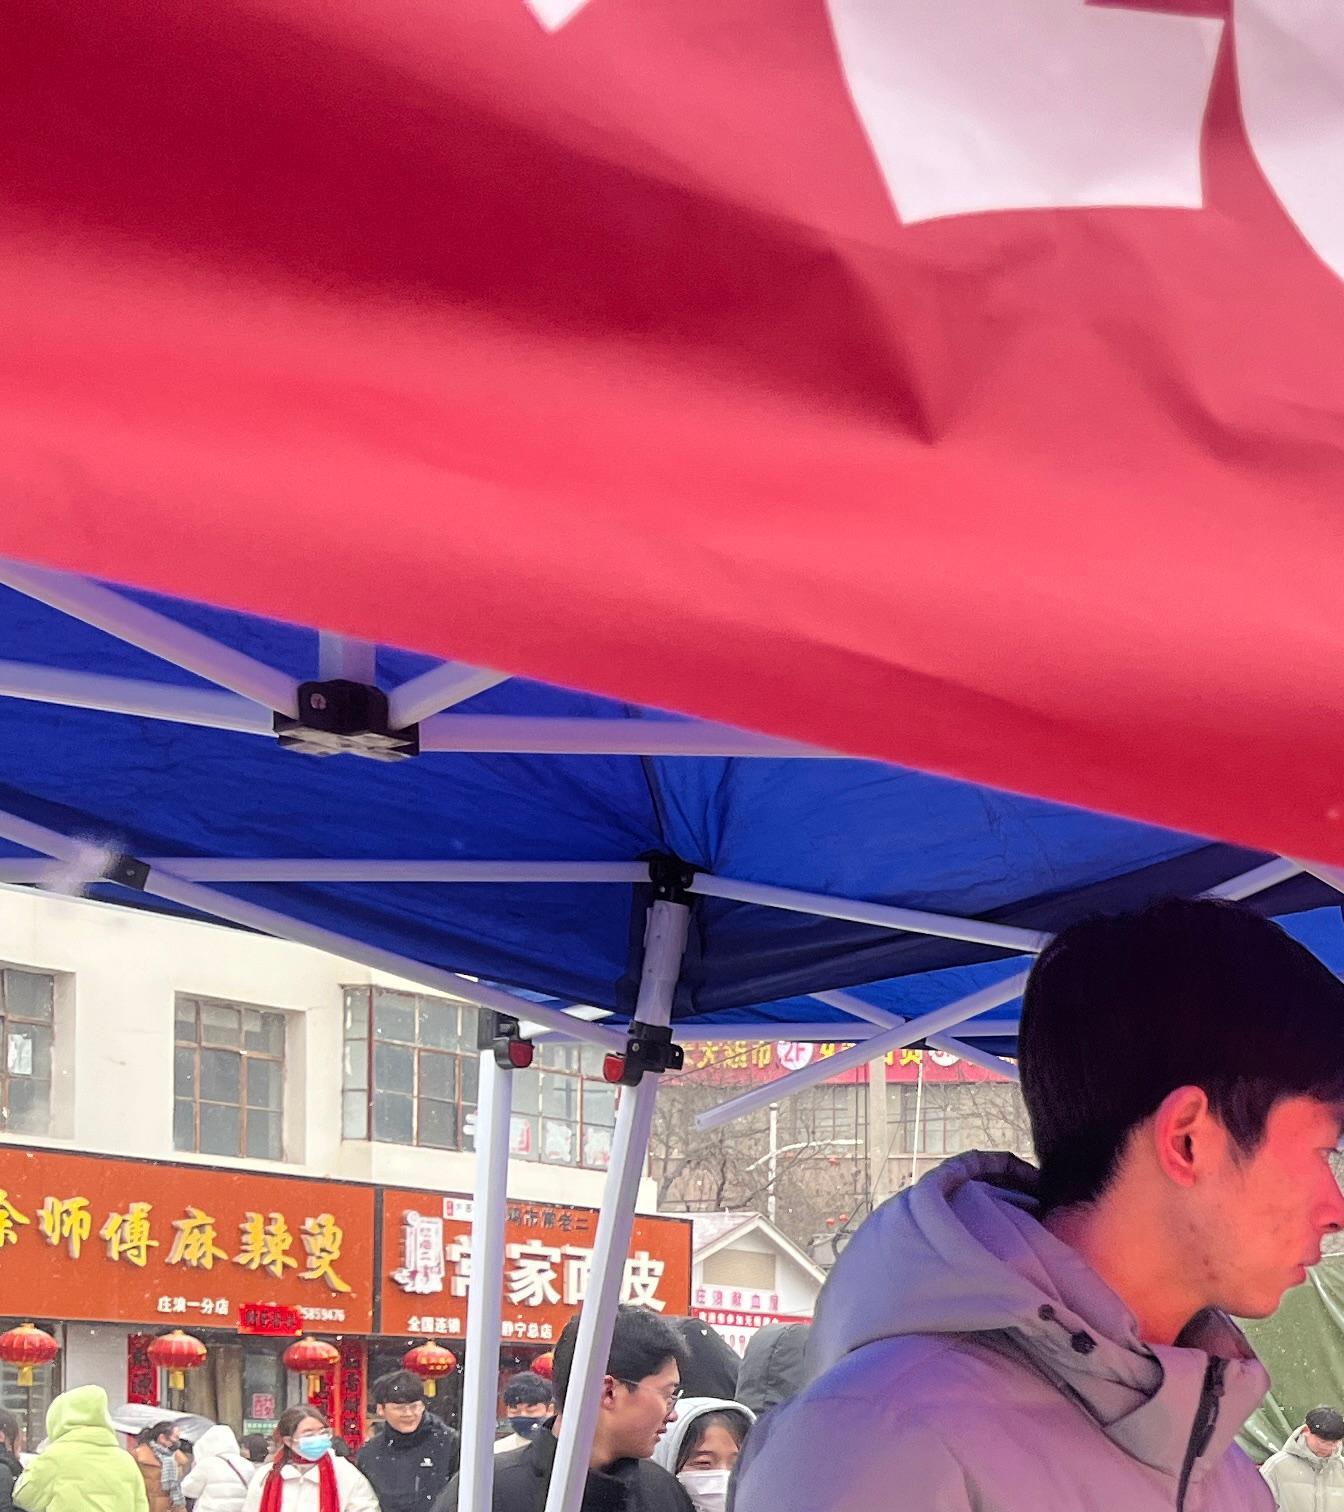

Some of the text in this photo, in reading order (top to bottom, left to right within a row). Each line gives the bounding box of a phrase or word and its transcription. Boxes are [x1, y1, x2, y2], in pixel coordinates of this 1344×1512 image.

[157, 1296, 229, 1316] 庄浪一分店
